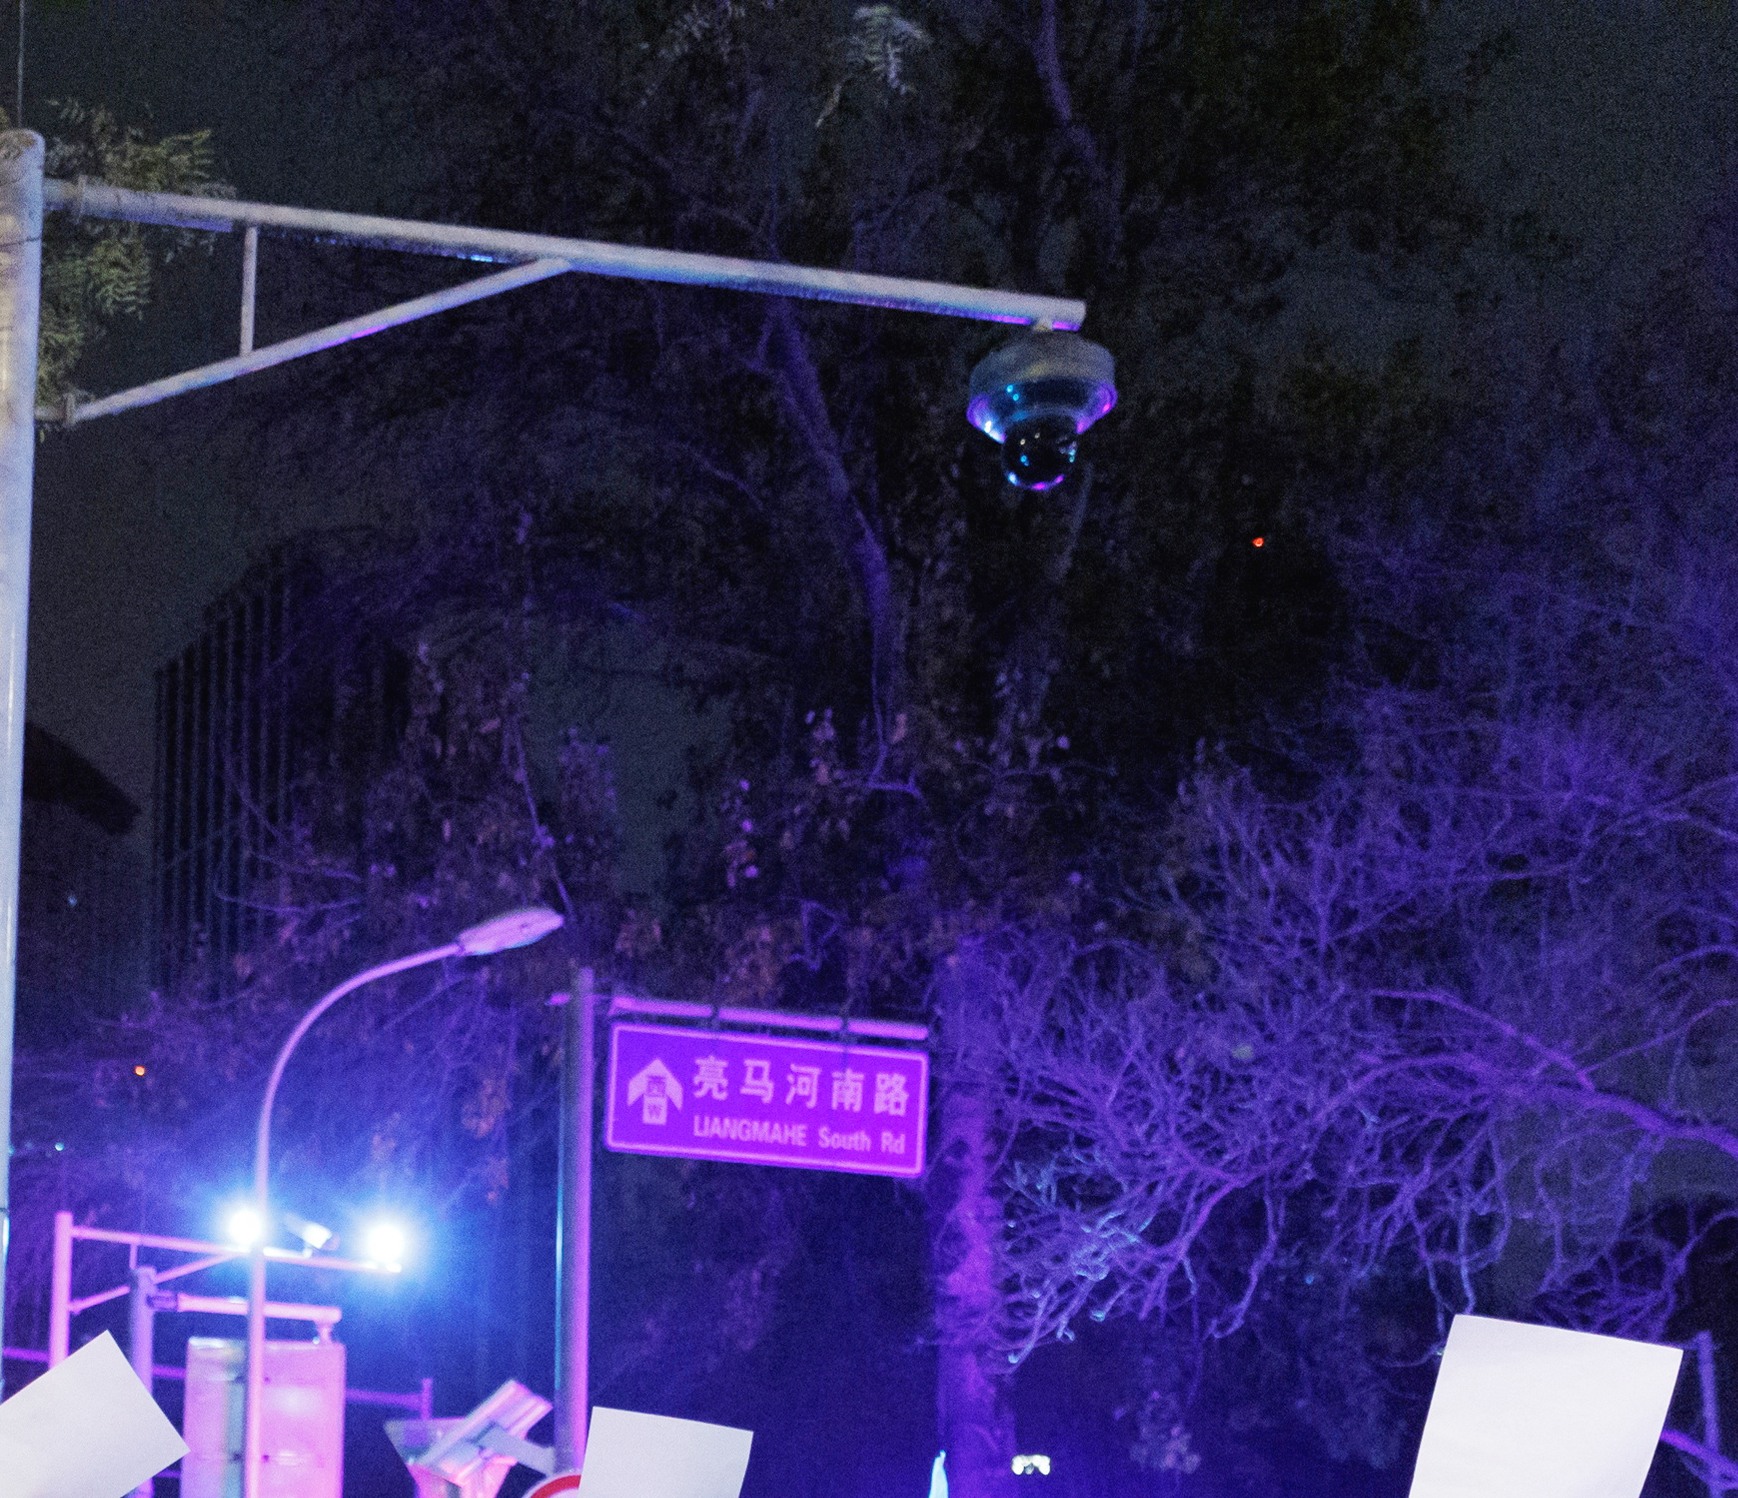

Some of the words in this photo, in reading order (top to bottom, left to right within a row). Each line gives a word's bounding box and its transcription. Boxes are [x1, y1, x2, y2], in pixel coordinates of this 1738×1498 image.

[693, 1055, 909, 1117] 亮马河南路
[693, 1115, 808, 1147] LIANGMAHE
[818, 1126, 872, 1153] South
[880, 1131, 906, 1155] Rd
